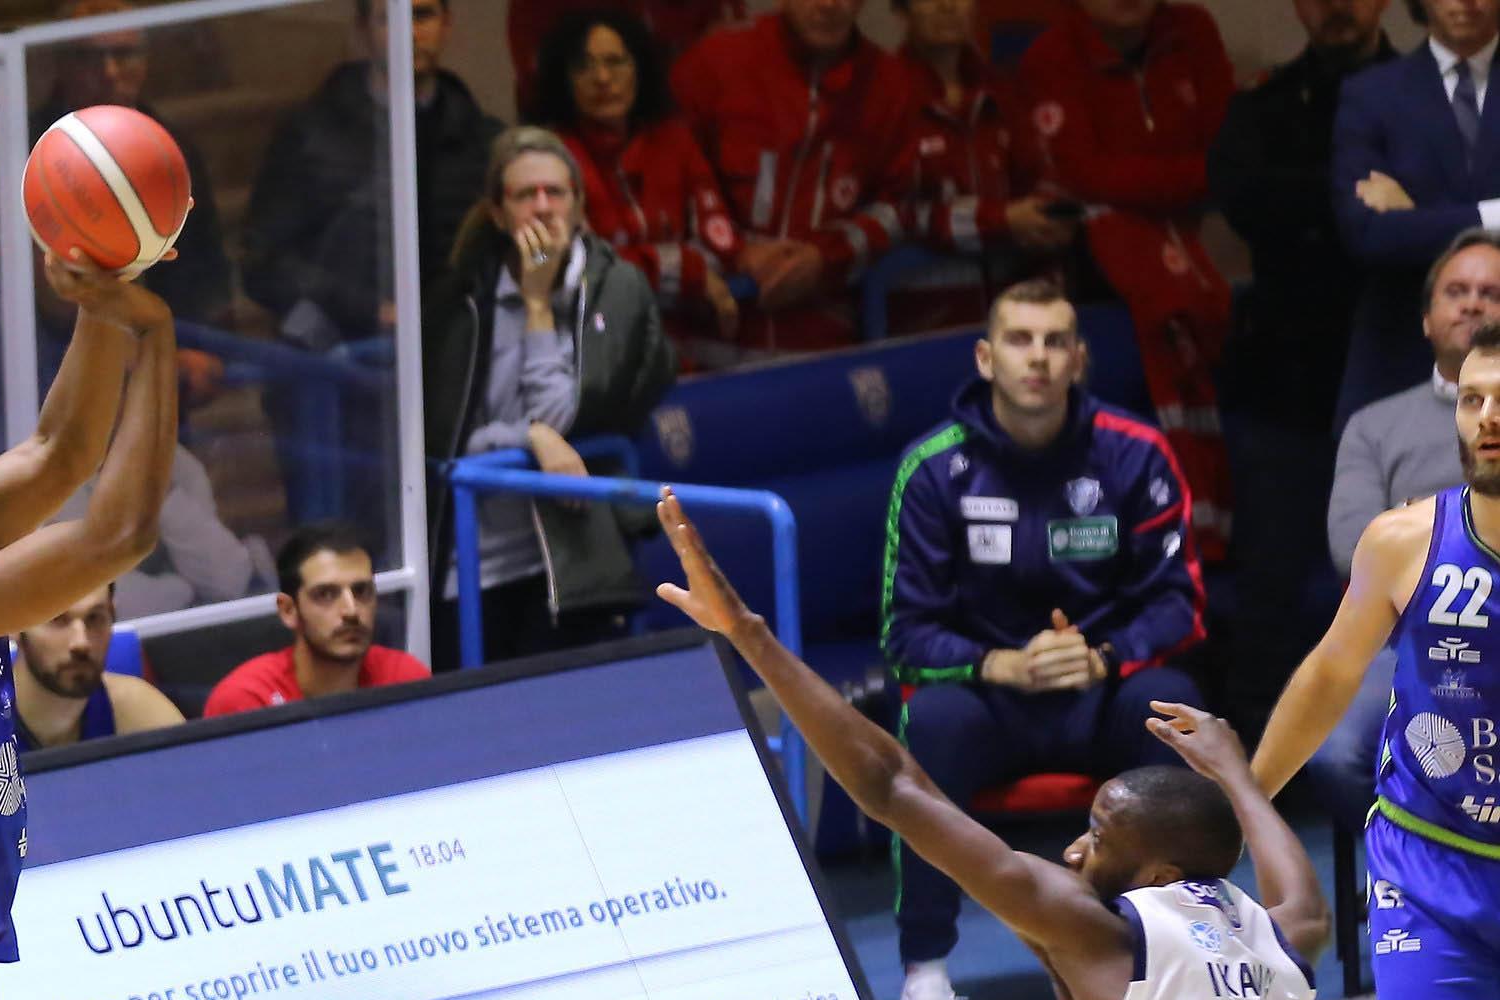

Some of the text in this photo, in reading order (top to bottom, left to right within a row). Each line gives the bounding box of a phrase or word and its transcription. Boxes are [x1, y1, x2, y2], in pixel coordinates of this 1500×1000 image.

[1428, 564, 1493, 629] 22
[408, 838, 467, 868] 18.04
[301, 950, 327, 982] il
[326, 948, 379, 977] tuo
[383, 928, 469, 966] nuovo
[473, 905, 584, 947] sistema
[588, 875, 728, 928] operativo.
